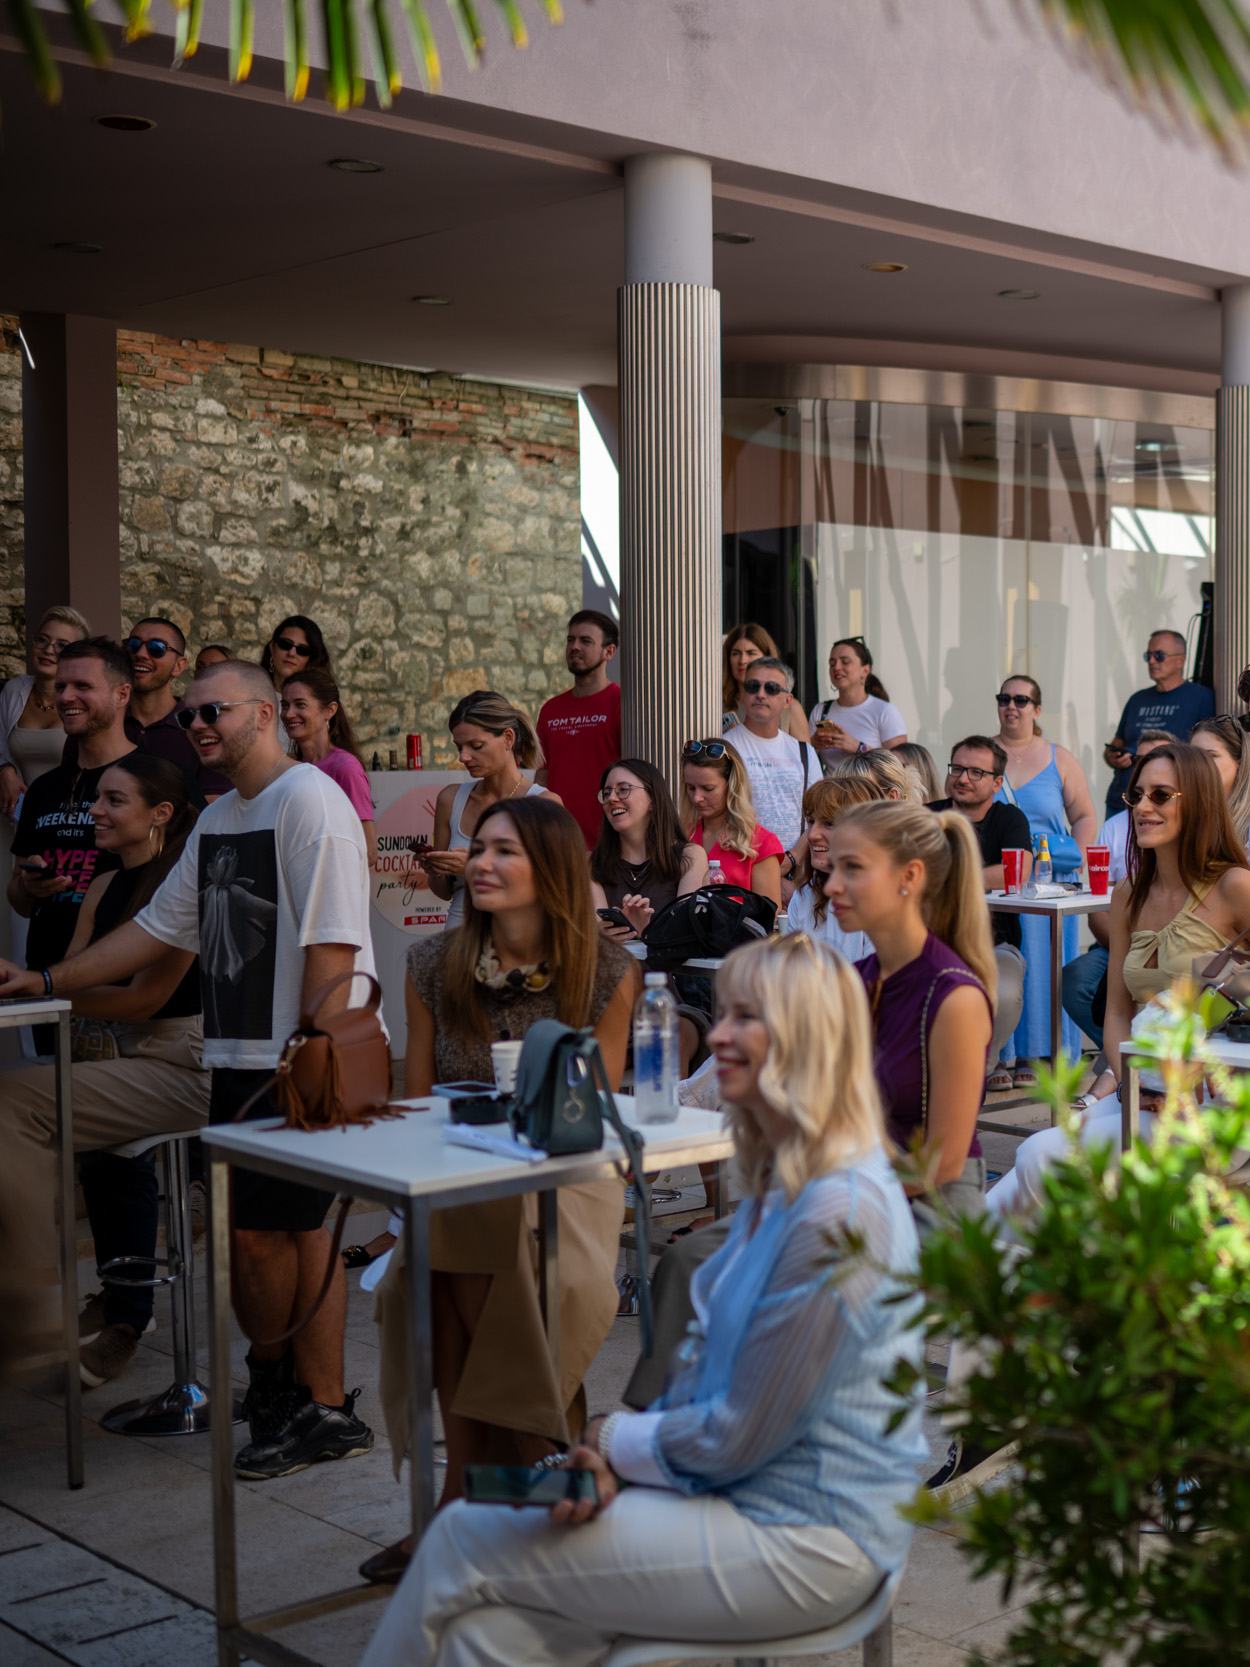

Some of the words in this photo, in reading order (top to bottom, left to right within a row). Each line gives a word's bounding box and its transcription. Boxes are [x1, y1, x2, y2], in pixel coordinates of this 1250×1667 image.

[547, 718, 569, 727] TOM
[569, 714, 607, 724] TAILOR
[44, 849, 99, 870] HYPE
[377, 870, 423, 906] party
[411, 916, 446, 924] SPAR
